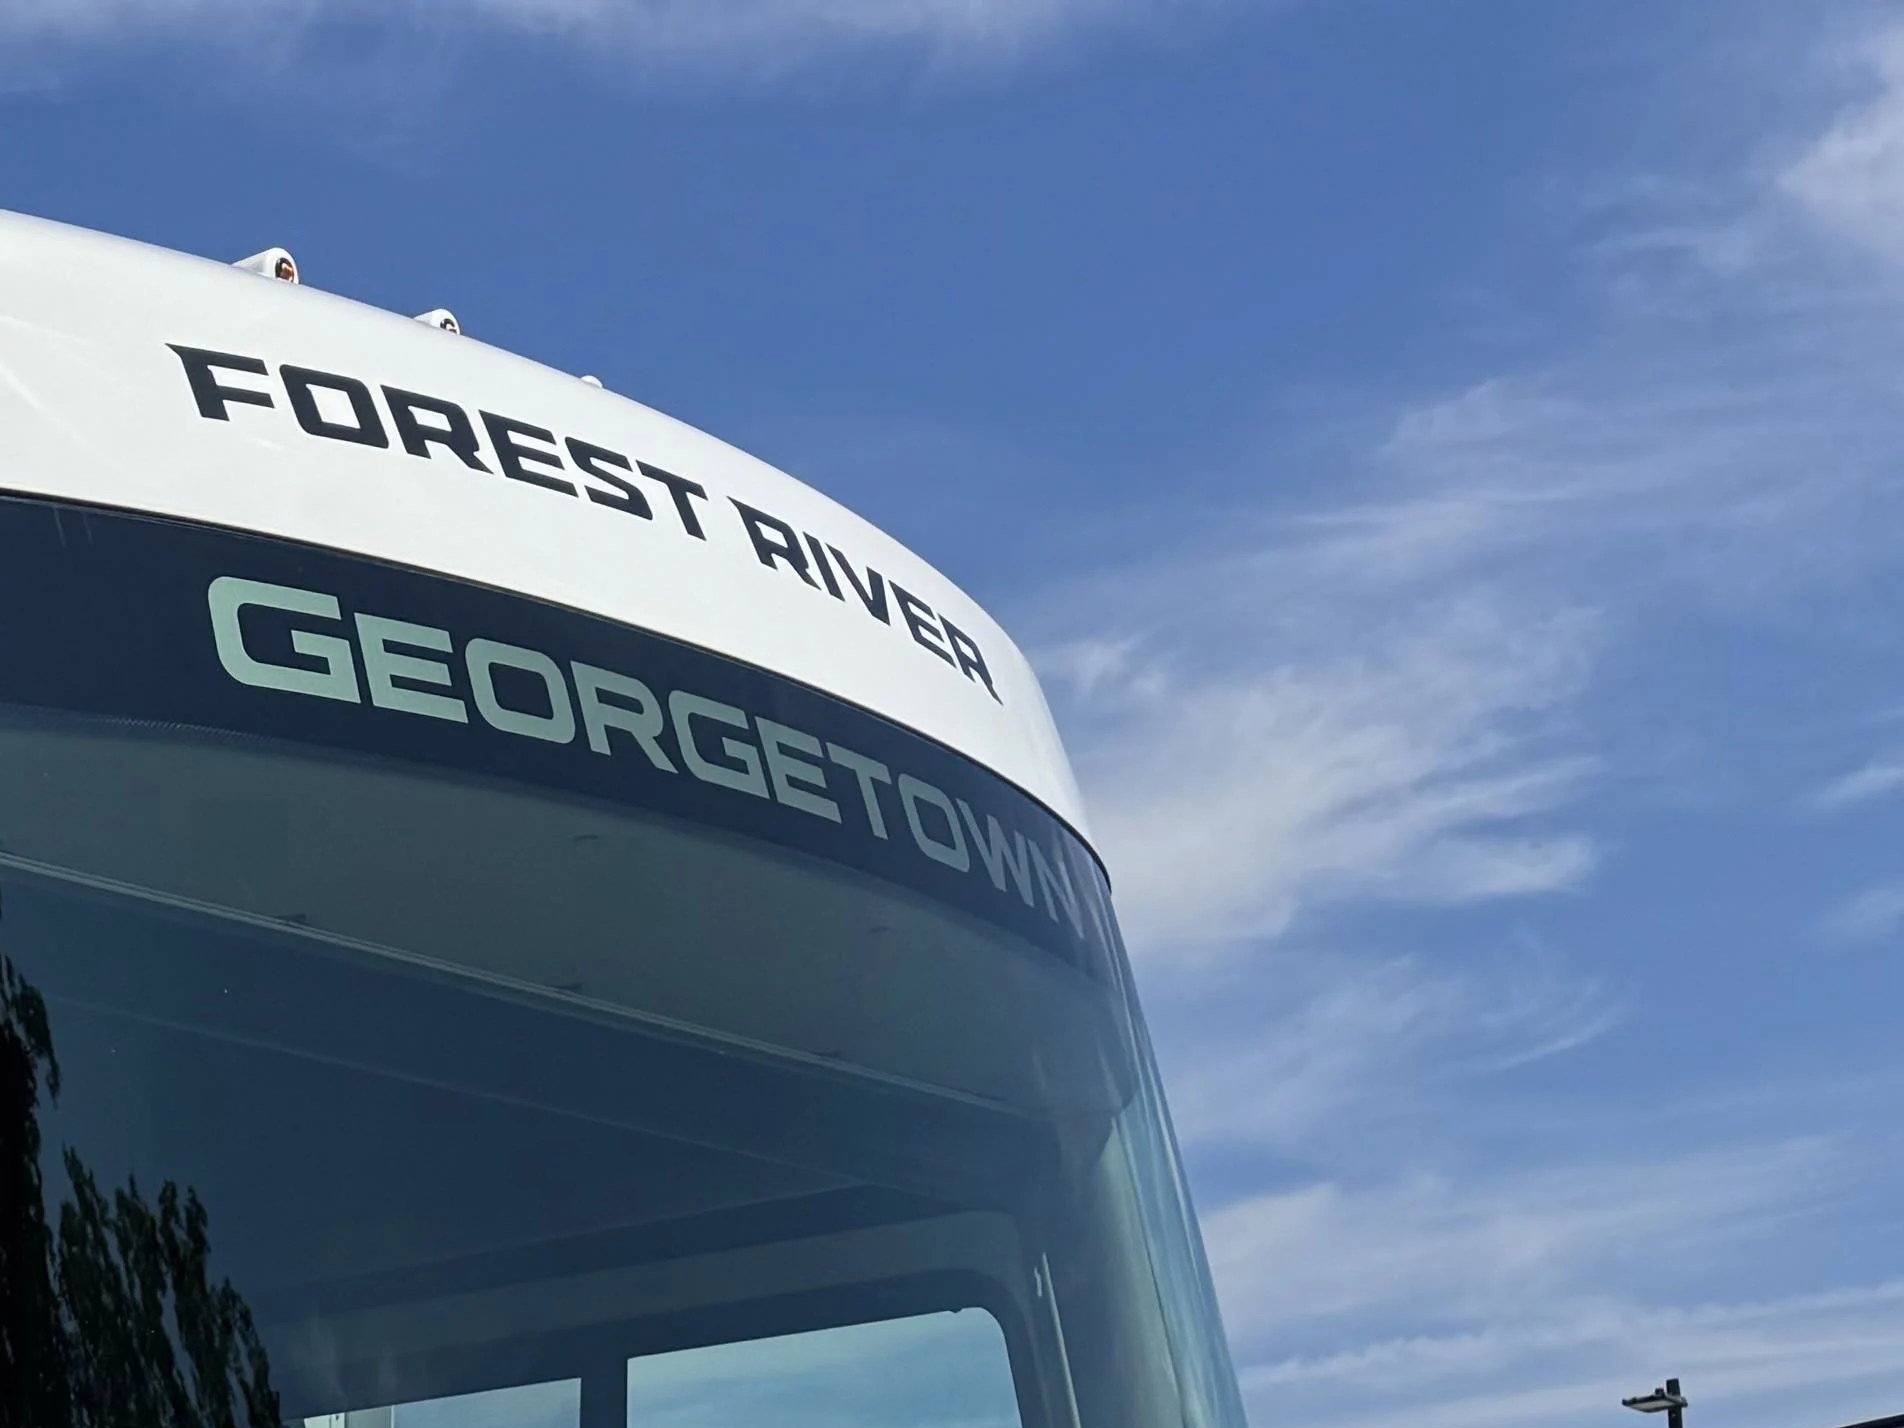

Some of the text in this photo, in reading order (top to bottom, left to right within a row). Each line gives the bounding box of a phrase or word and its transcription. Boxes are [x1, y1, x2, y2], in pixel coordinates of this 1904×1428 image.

[165, 343, 1004, 705] FOREST RIVER
[207, 575, 1085, 940] GEORGETOWN
